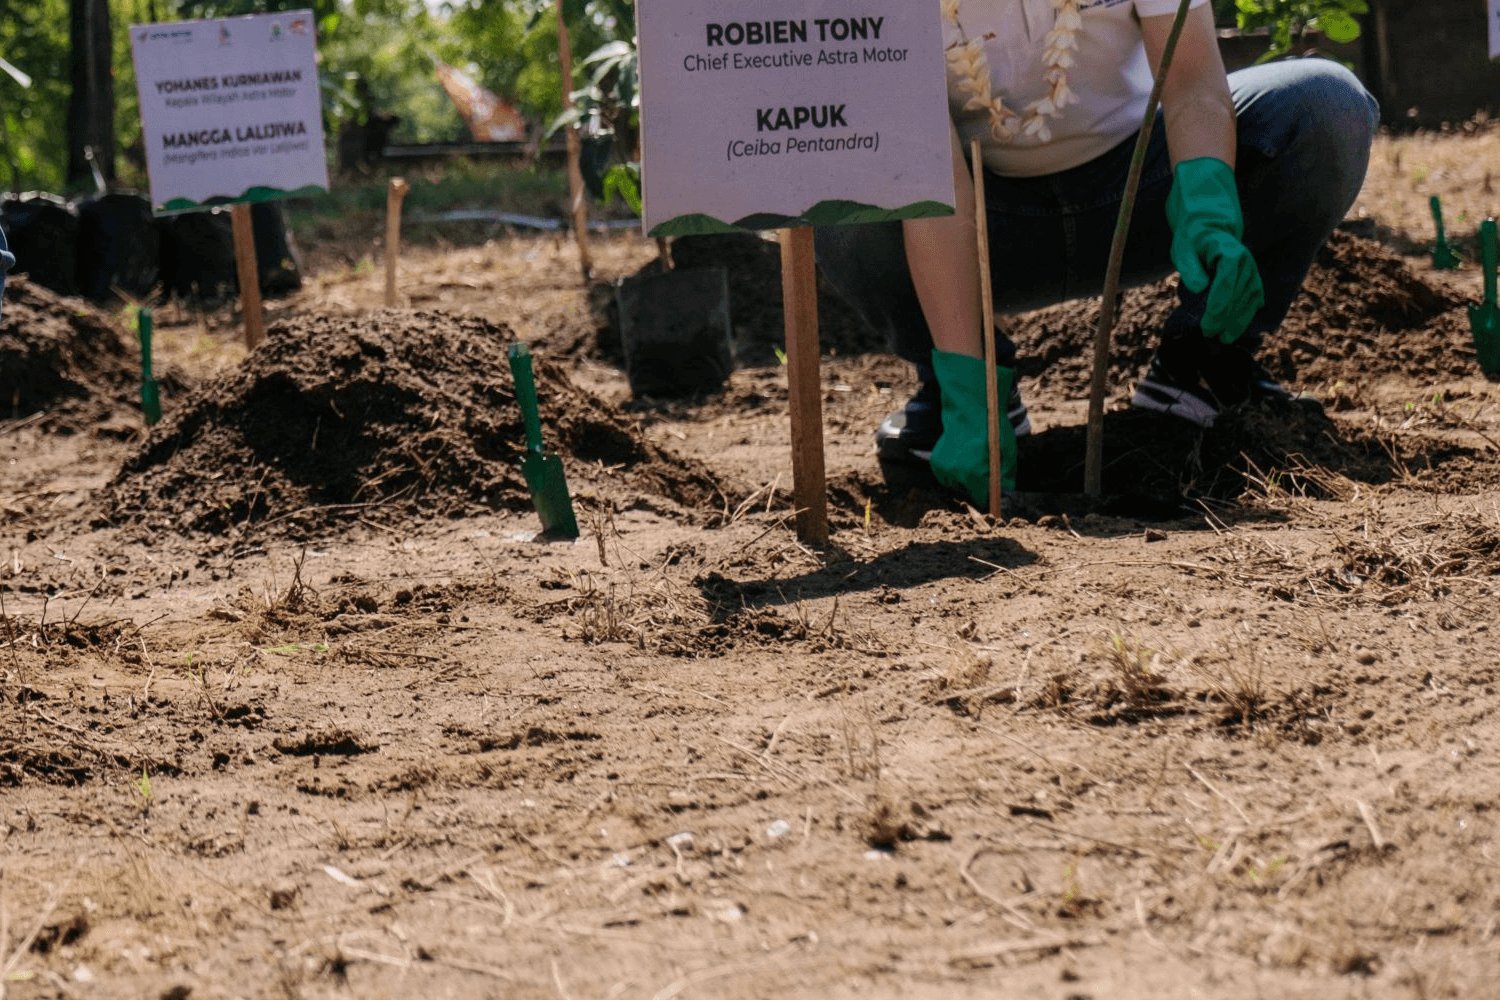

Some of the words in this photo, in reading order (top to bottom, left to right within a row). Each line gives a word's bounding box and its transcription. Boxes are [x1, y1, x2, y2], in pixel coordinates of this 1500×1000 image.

[706, 20, 807, 46] ROBIEN
[814, 16, 884, 42] TONY
[683, 53, 729, 72] Chief
[733, 50, 813, 69] Executive
[817, 49, 858, 66] Astra
[863, 47, 908, 63] Motor
[756, 104, 848, 132] KAPUK
[726, 141, 781, 161] (Ceiba
[786, 132, 880, 154] Pentandra)
